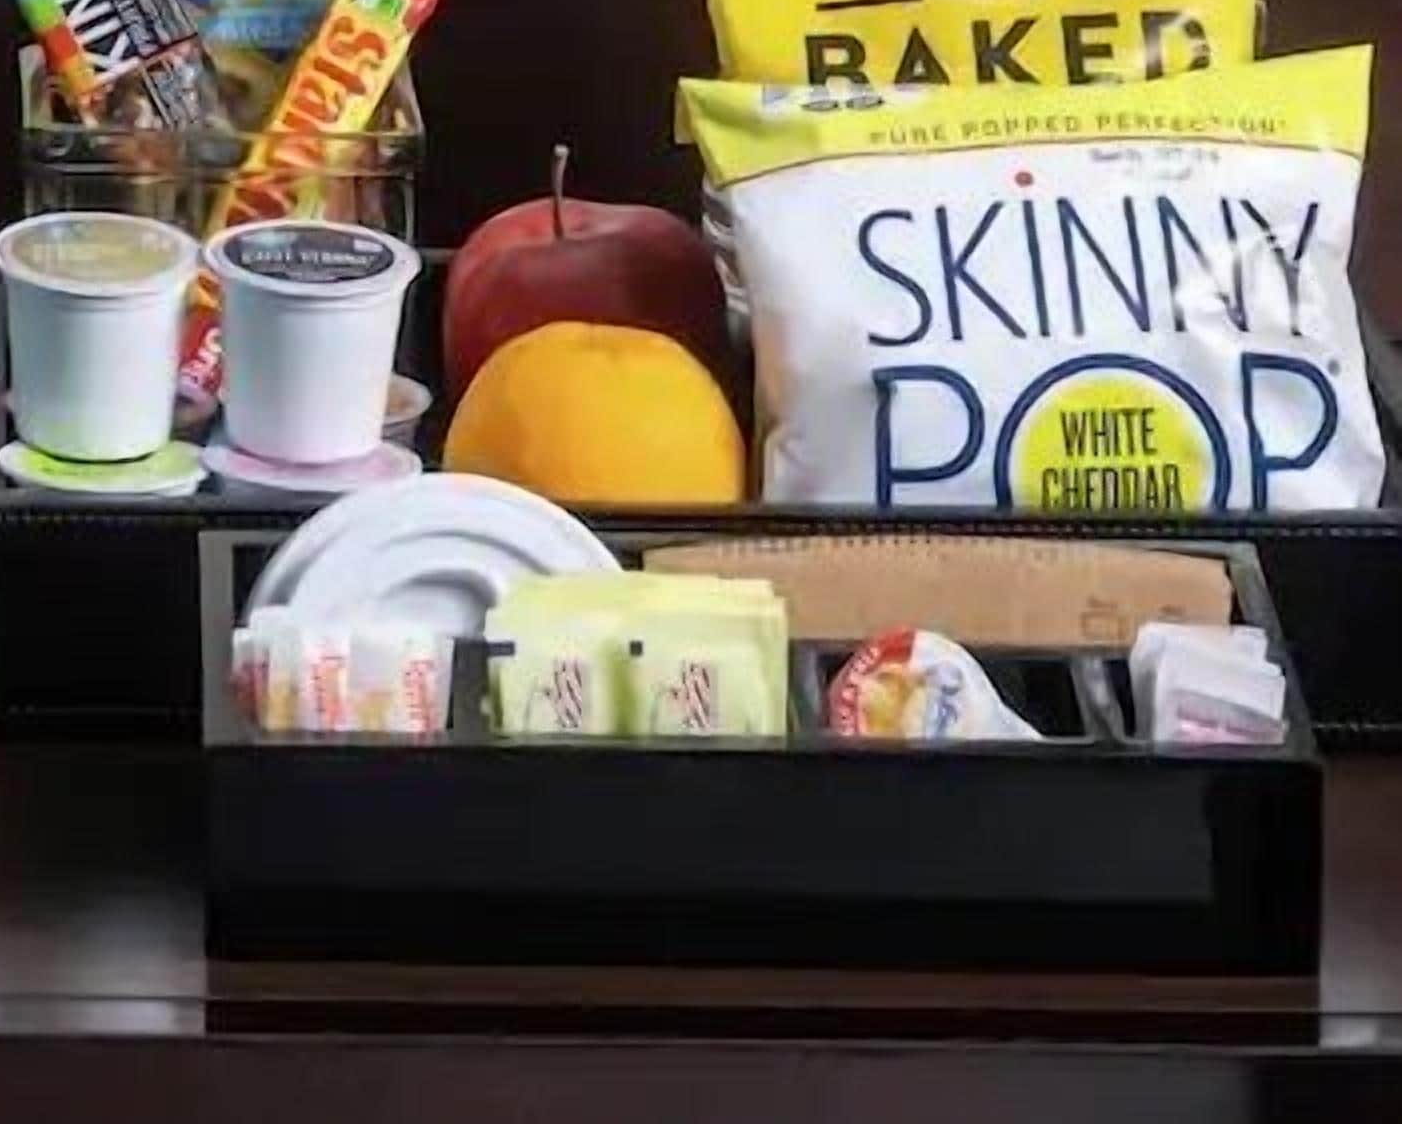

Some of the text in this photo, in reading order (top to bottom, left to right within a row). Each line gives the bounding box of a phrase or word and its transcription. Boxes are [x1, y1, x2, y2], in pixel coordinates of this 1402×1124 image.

[804, 10, 1211, 86] BAKED
[962, 114, 1079, 138] POPPED
[870, 351, 1339, 511] POP
[1059, 407, 1158, 457] WHITE
[1041, 463, 1183, 511] CHEDDAR
